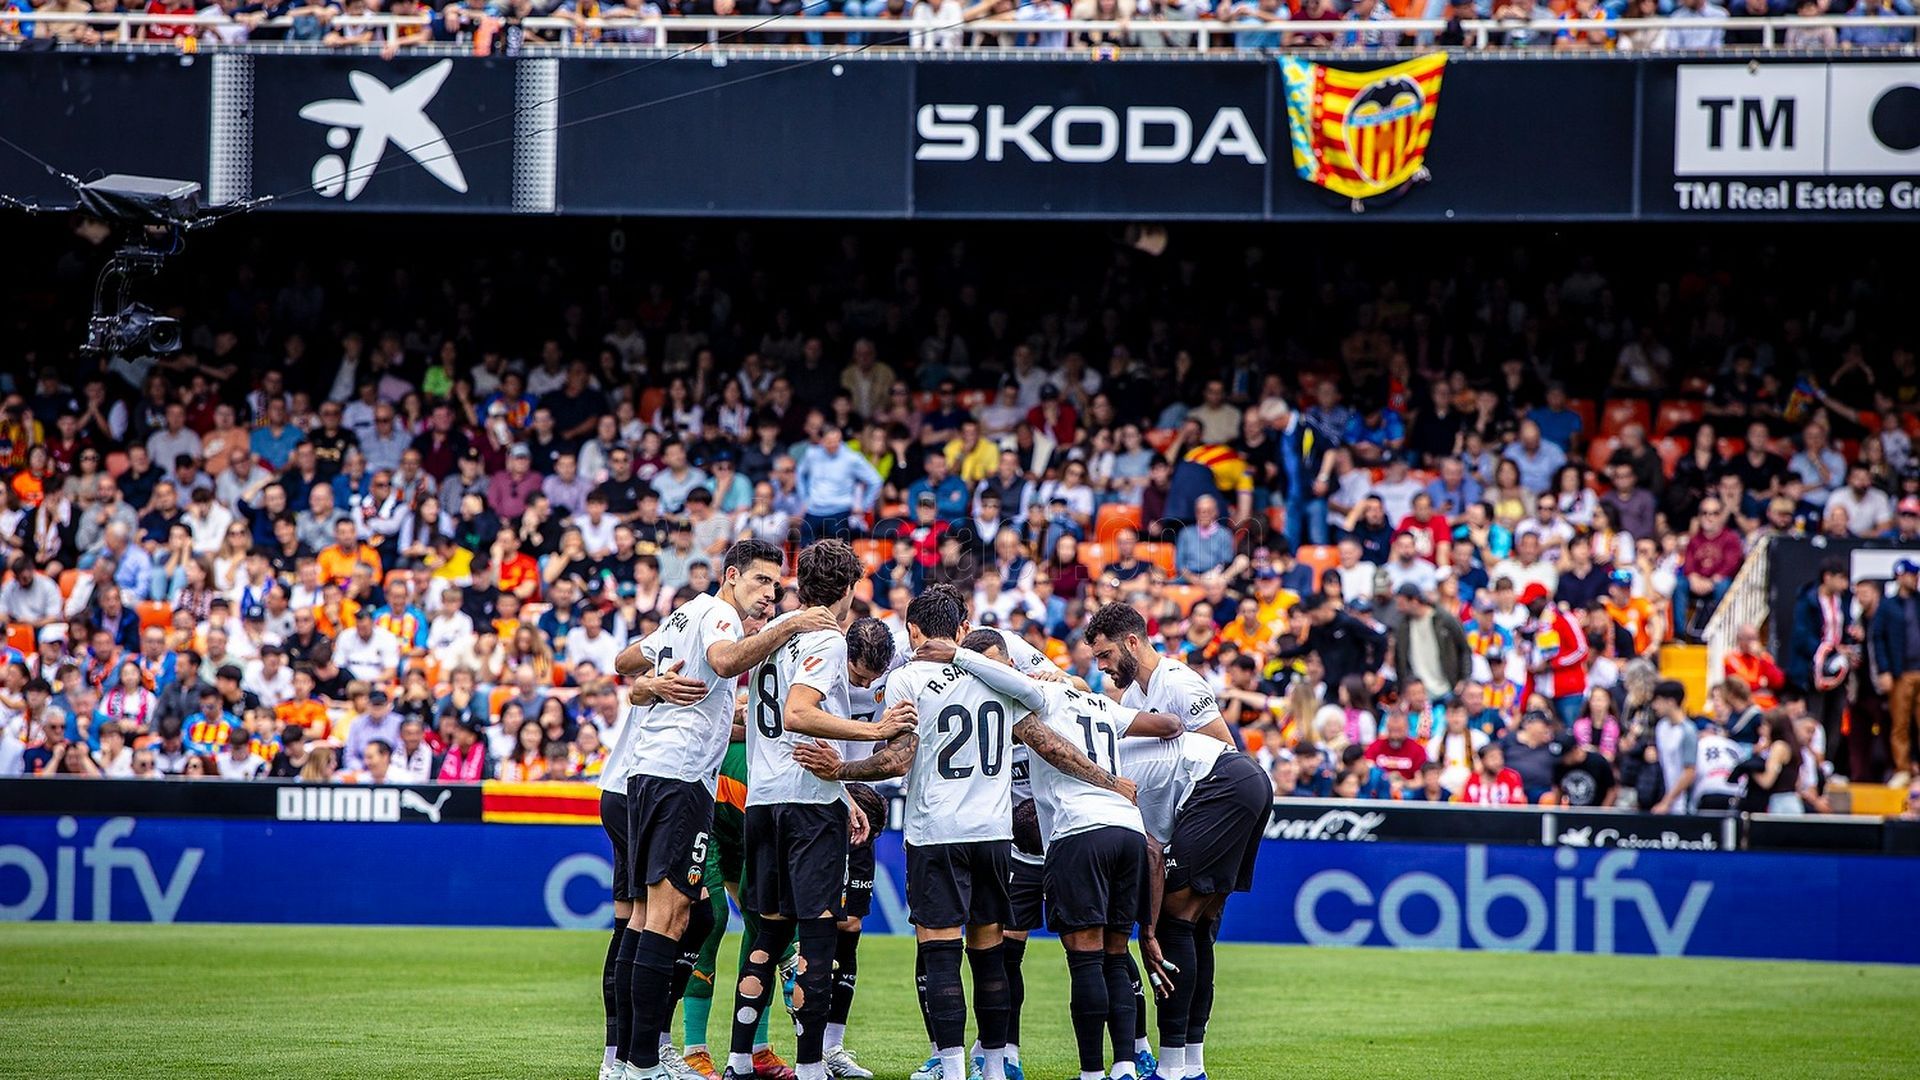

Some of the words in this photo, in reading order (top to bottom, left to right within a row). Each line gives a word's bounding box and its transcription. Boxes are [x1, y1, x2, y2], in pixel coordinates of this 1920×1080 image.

[1698, 97, 1796, 150] TM
[1674, 182, 1722, 210] TM
[1727, 180, 1789, 210] Real
[1796, 181, 1884, 210] Estate
[757, 662, 783, 739] 8
[937, 700, 1005, 780] 20
[691, 831, 709, 864] 5
[1294, 845, 1714, 957] cabify
